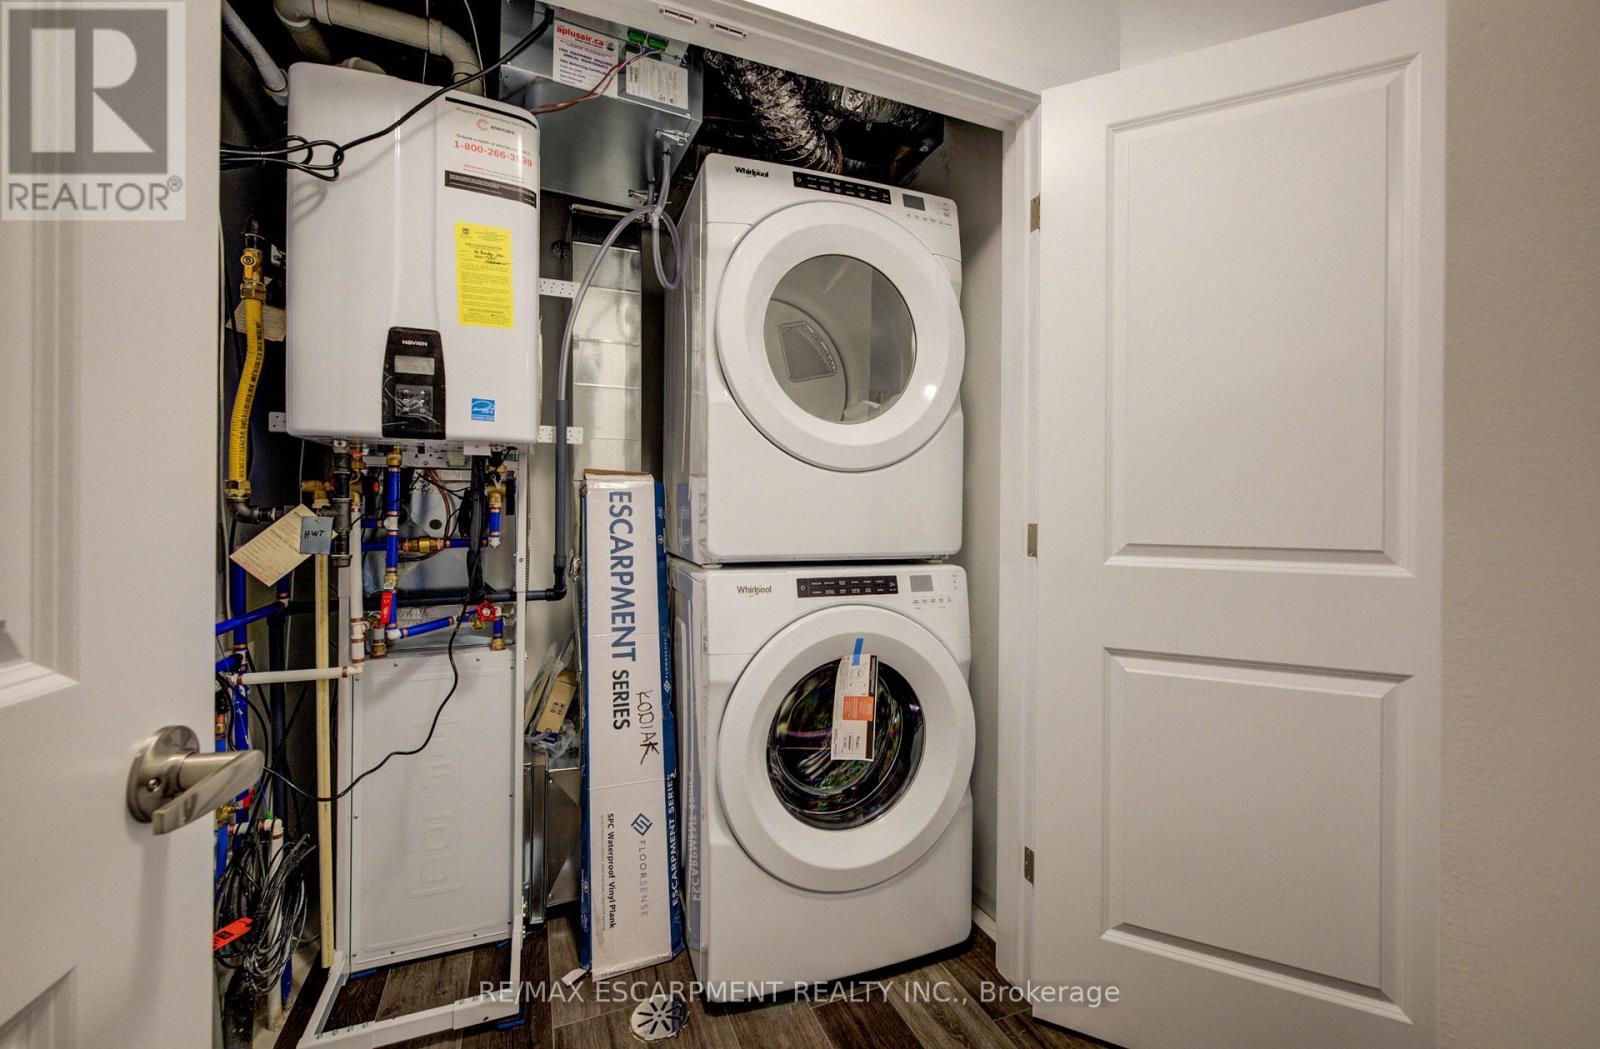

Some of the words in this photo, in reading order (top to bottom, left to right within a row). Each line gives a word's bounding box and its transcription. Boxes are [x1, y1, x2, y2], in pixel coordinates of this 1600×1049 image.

[556, 25, 605, 47] aplusair.ca
[735, 166, 769, 178] Whirlpool
[304, 529, 326, 539] HWT
[608, 491, 636, 662] ESCARPMENT
[736, 585, 772, 598] Whirlpool
[612, 670, 630, 730] SERIES
[636, 691, 660, 765] KODIAK
[606, 813, 615, 830] SPC
[606, 831, 616, 880] Waterproof
[668, 817, 680, 907] ESCARPMENT
[606, 881, 616, 903] Vinyl
[638, 839, 649, 920] FLOORSENSE
[608, 905, 617, 930] Plank
